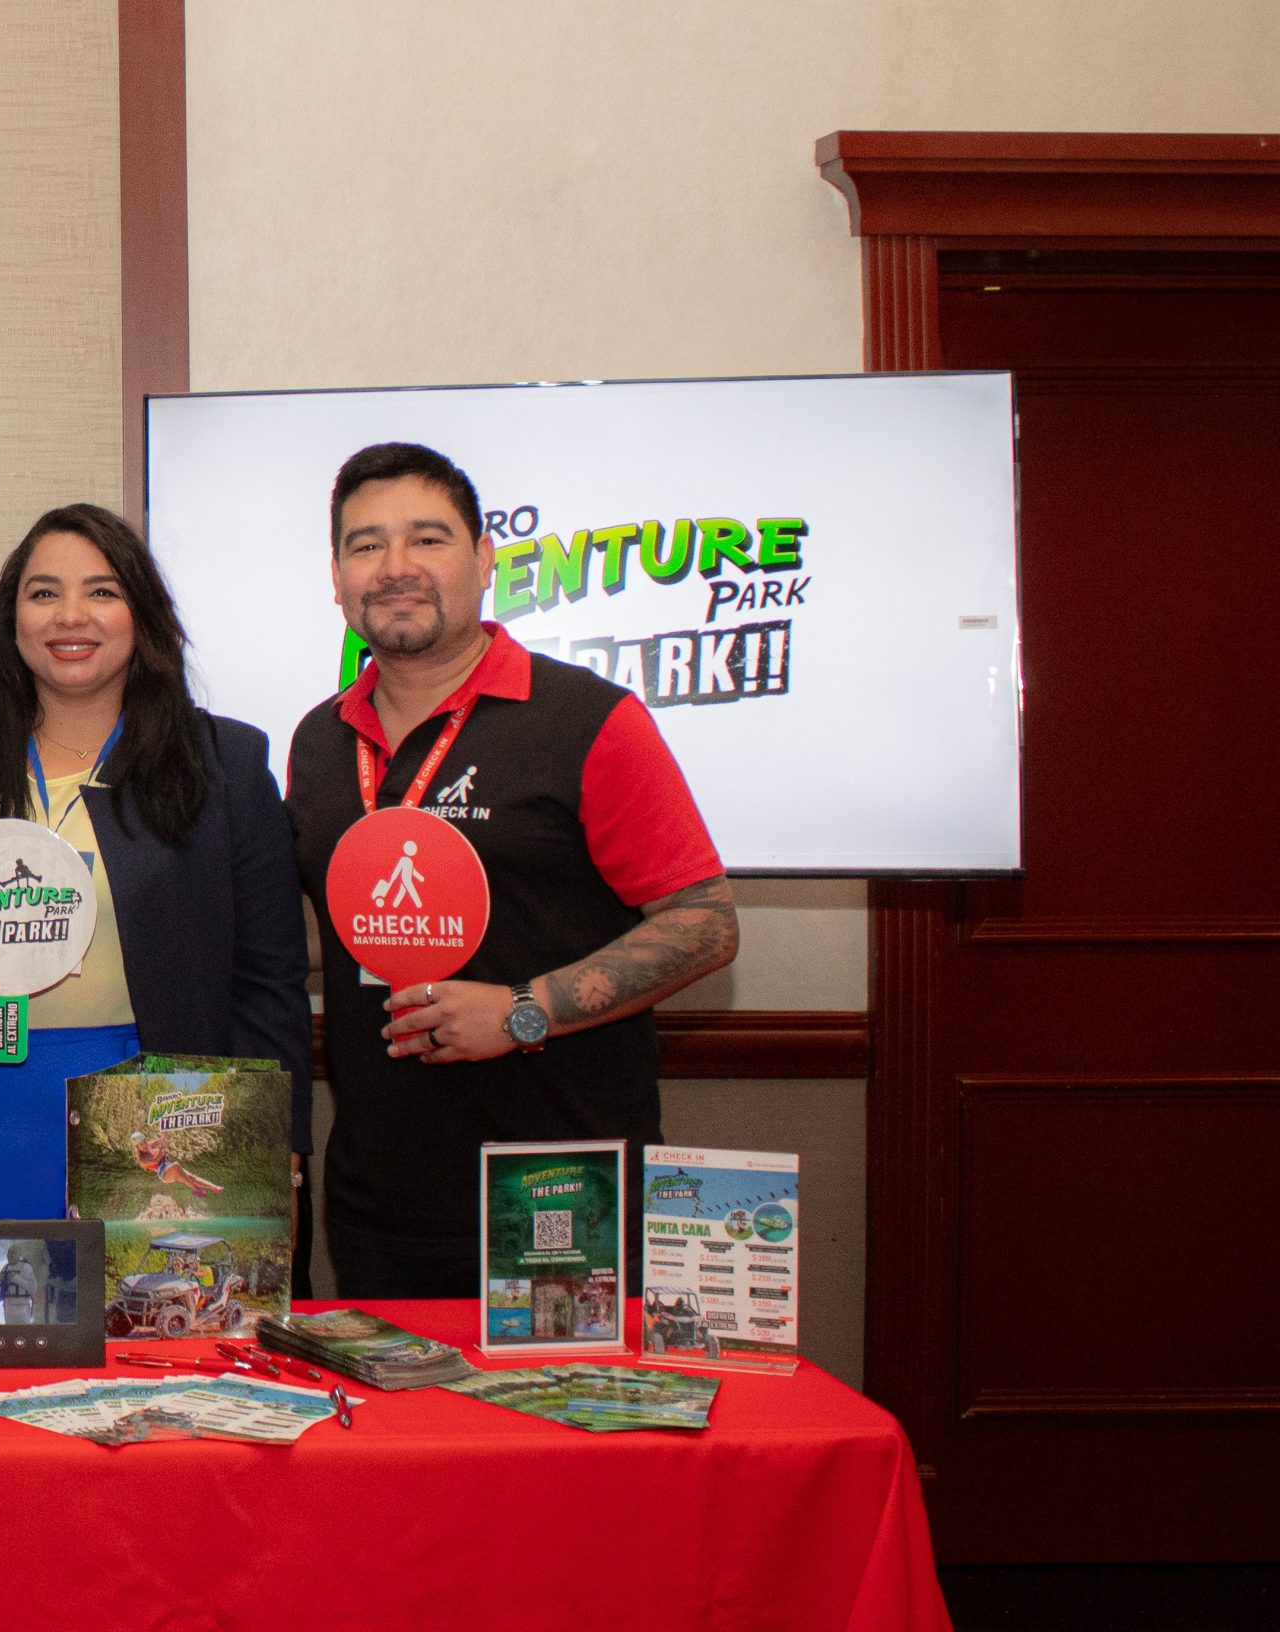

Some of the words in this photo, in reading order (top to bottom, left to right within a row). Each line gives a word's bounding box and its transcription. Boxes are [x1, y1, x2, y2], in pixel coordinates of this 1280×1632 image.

[484, 505, 539, 539] RO
[493, 517, 809, 623] ENTURE
[706, 577, 811, 624] PARK
[361, 749, 370, 776] CHECK
[421, 750, 442, 777] CHECK
[440, 738, 449, 748] IN
[362, 779, 371, 788] IN
[472, 807, 491, 820] IN
[45, 904, 76, 918] PARK
[3, 919, 69, 944] PARK!!
[352, 914, 431, 935] CHECK
[439, 915, 463, 936] IN
[353, 936, 410, 946] MAYORISTA
[413, 936, 426, 946] DE
[429, 937, 465, 947] VIAJES
[7, 1003, 18, 1041] EXTREMO
[7, 1044, 17, 1055] AL
[149, 1095, 222, 1124] ADVENTURE
[161, 1115, 184, 1131] THE
[664, 1152, 692, 1160] CHECK
[531, 1186, 550, 1198] THE
[647, 1221, 678, 1235] PUNTA
[681, 1223, 711, 1237] CANA
